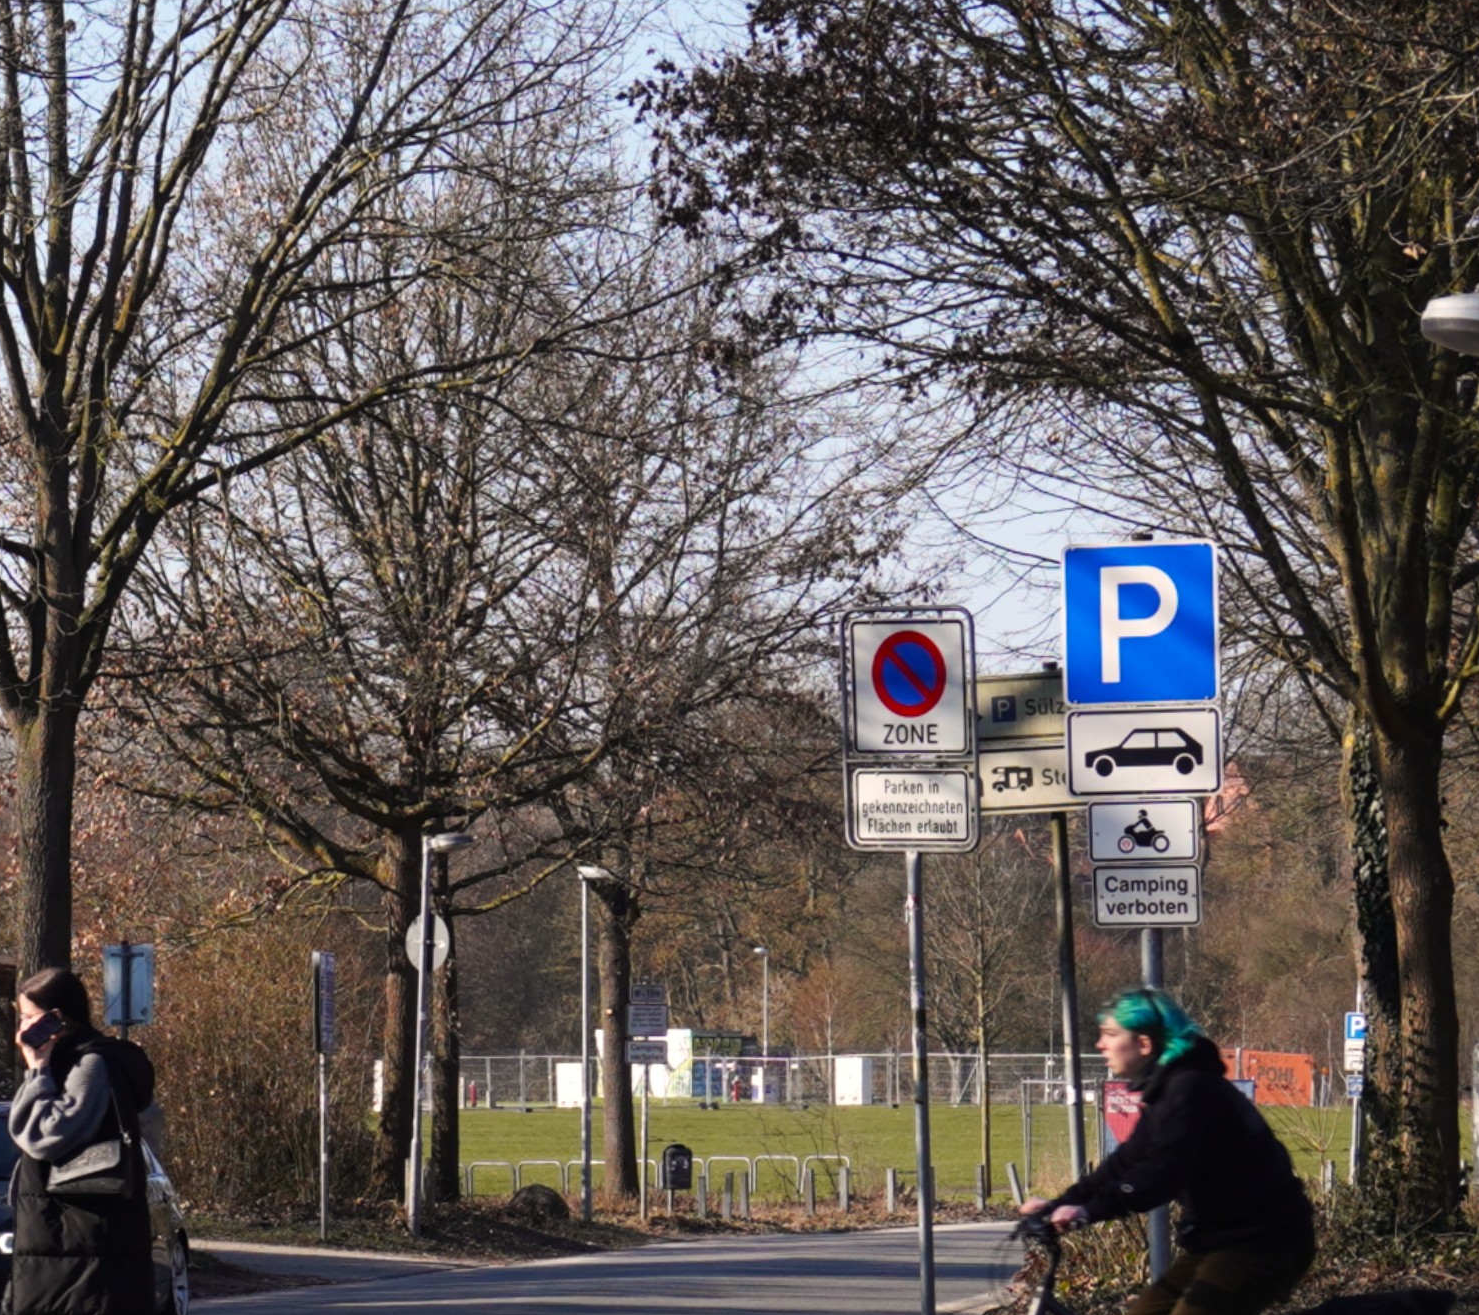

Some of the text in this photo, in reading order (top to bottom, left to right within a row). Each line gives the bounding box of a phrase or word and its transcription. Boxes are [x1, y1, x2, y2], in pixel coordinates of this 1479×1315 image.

[1100, 565, 1179, 684] P
[997, 699, 1010, 719] P
[883, 724, 938, 744] ZONE
[884, 778, 939, 794] Parken in
[862, 799, 963, 818] gekennzeichneten
[868, 817, 958, 834] Flächen erlaubt
[1104, 875, 1188, 896] Camping
[1106, 898, 1188, 915] verboten
[1350, 1015, 1366, 1037] P
